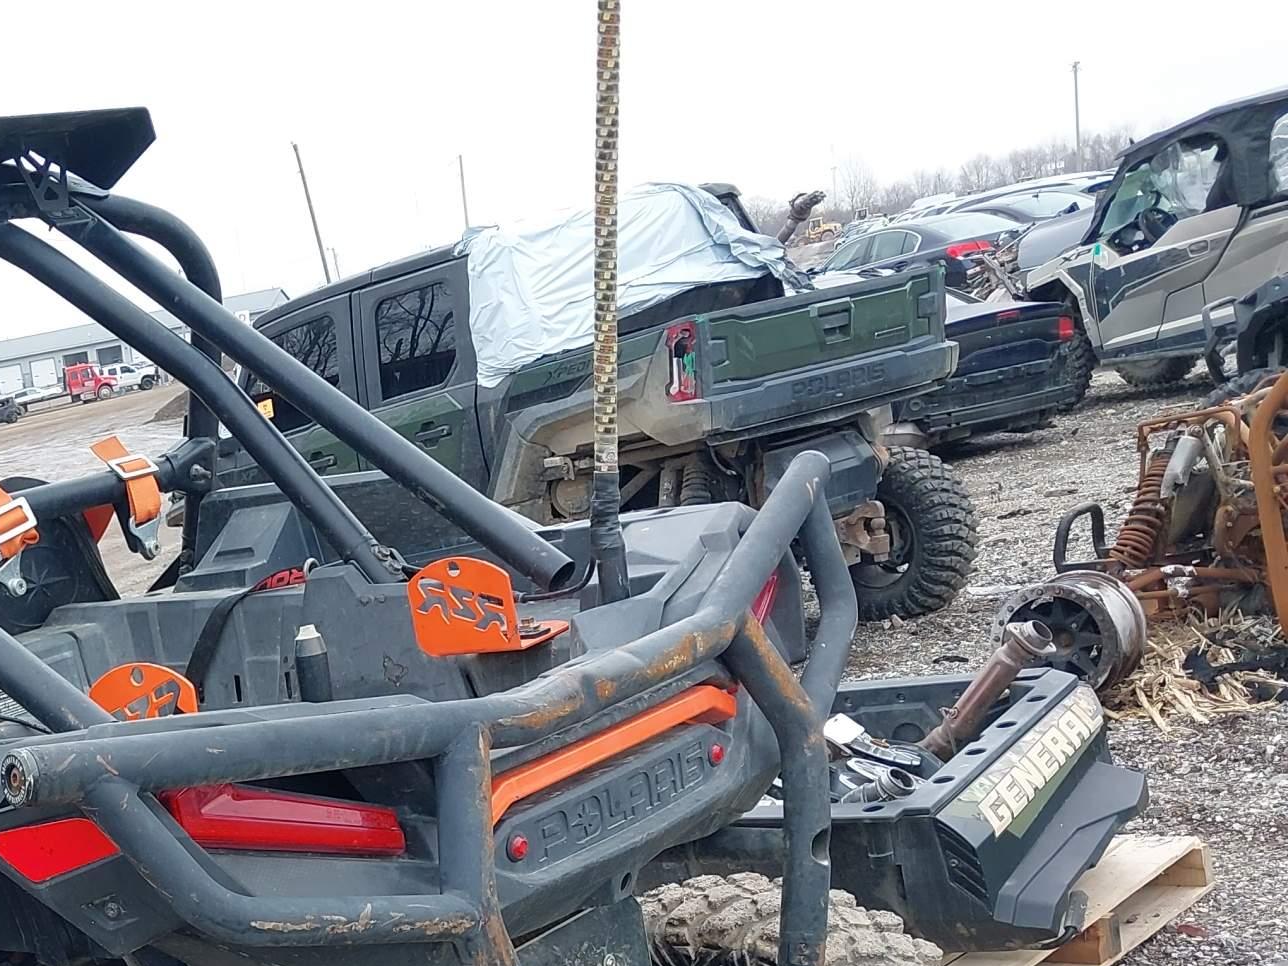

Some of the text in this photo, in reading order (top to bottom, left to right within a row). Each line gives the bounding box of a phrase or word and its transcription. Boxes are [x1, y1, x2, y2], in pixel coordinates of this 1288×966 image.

[792, 361, 889, 401] POLARIS
[533, 741, 705, 863] POLARIS
[977, 703, 1104, 839] GENERAL
